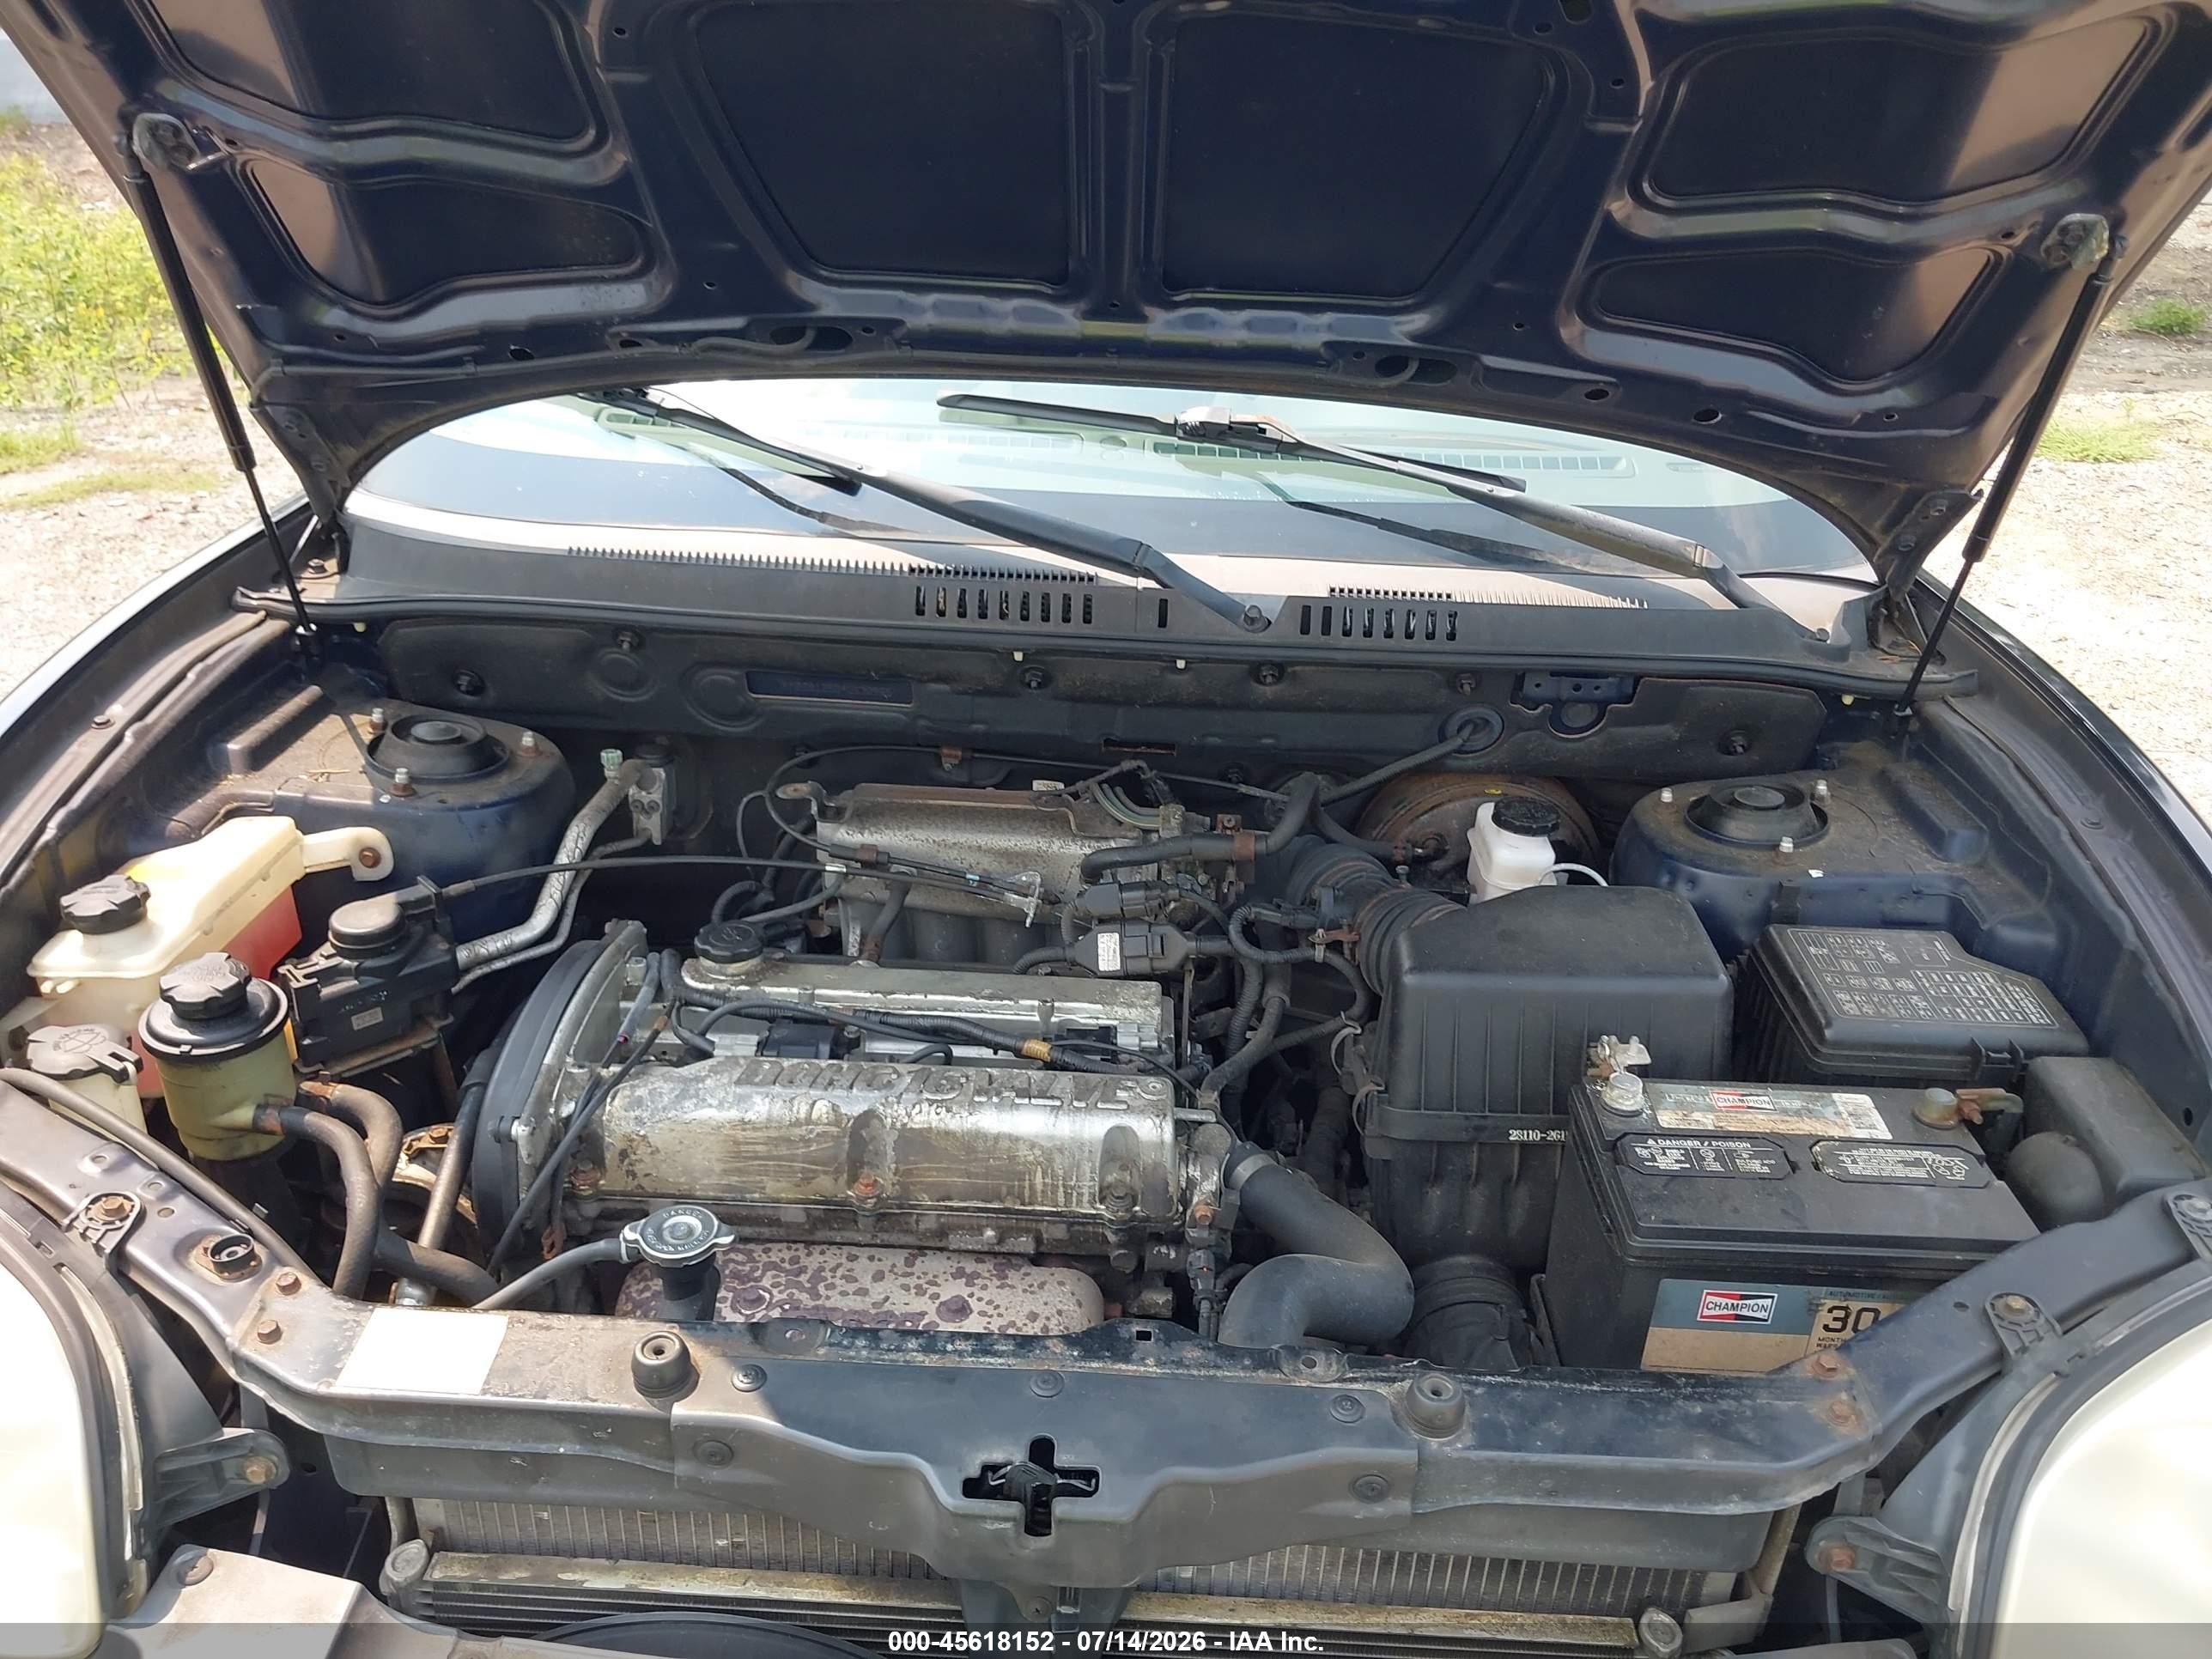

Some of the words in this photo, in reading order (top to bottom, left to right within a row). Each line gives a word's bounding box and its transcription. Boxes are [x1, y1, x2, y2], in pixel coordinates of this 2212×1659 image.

[1716, 1096, 1772, 1107] CHAMPION
[1657, 1139, 1701, 1147] DANGER
[1705, 1301, 1770, 1313] CHAMPION
[1822, 1305, 1881, 1334] 30
